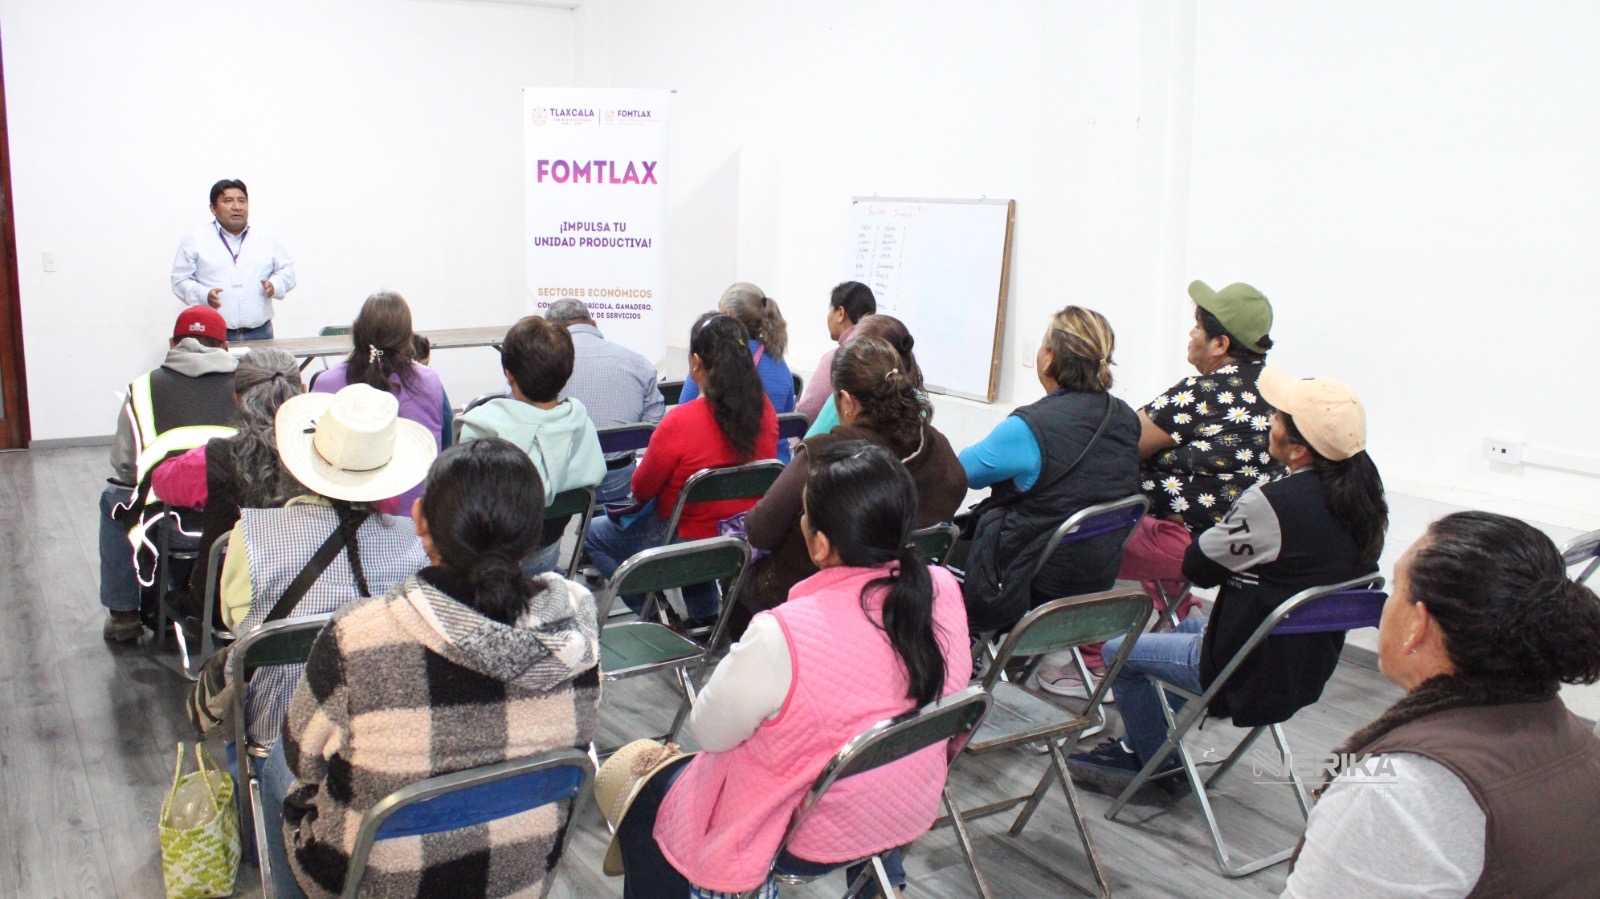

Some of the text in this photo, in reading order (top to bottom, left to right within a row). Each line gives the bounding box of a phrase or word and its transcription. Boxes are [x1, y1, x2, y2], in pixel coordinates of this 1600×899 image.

[550, 108, 595, 117] TLAXCALA
[617, 109, 651, 118] FOMTLAX
[537, 160, 658, 184] FOMTLAX
[560, 221, 627, 233] ¡IMPULSA TU
[534, 237, 652, 248] UNIDAD PRODUCTIVA!
[538, 288, 585, 297] SECTORES
